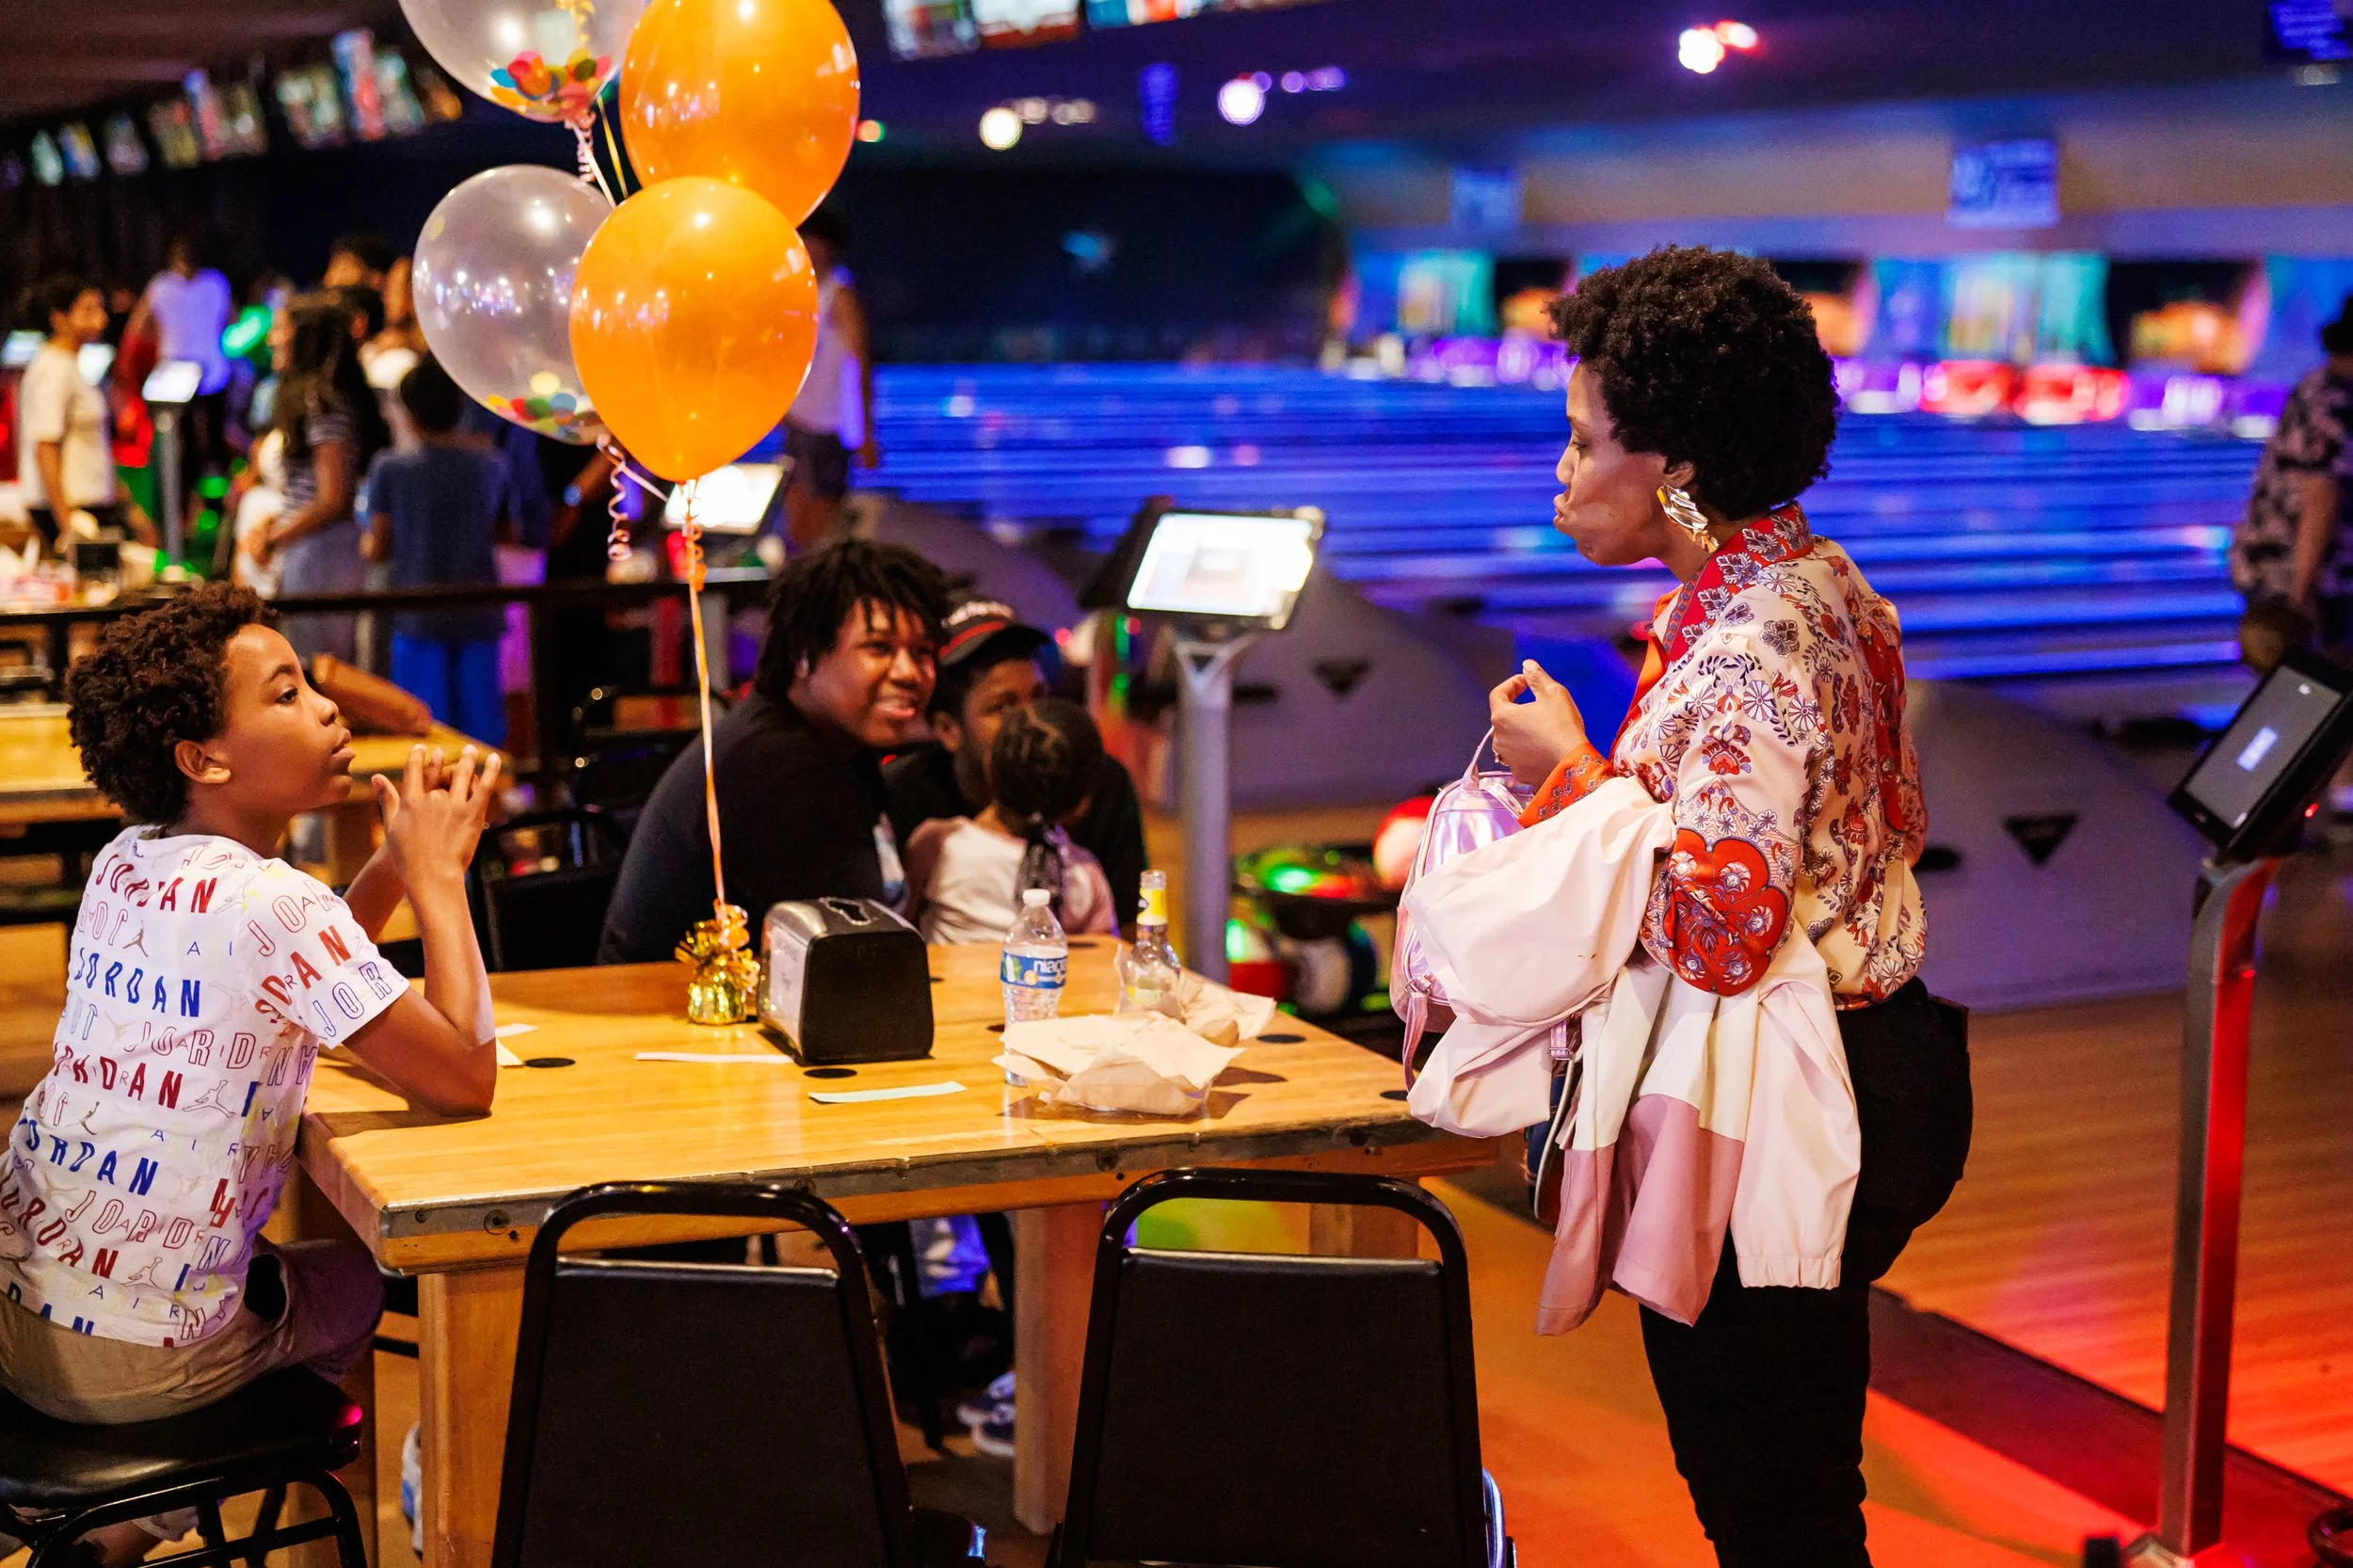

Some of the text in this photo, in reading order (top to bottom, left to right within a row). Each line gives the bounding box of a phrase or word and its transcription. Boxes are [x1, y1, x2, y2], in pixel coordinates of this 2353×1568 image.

[74, 947, 200, 1017] JORDAN
[54, 1041, 184, 1110] ORDAN
[19, 1118, 159, 1196] ORDAN
